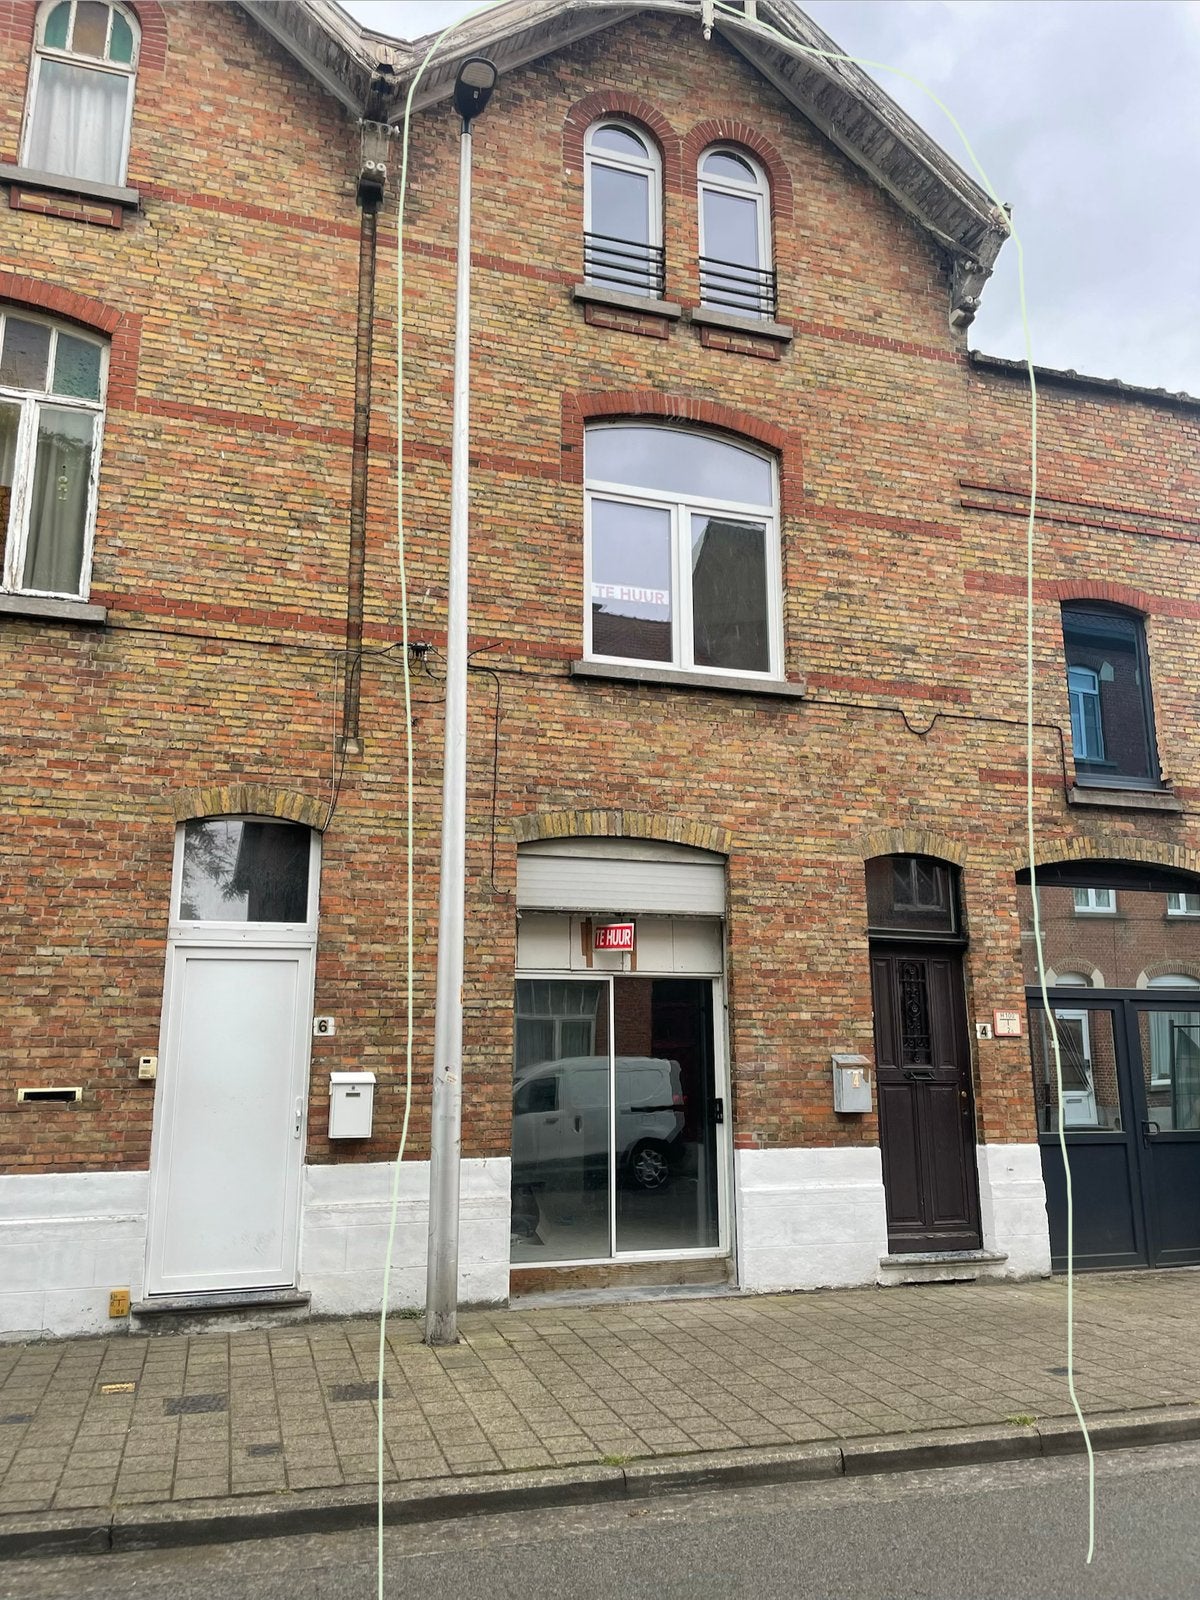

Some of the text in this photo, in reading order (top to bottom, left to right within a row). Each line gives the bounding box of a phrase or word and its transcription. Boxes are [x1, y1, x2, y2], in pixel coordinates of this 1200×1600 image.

[595, 585, 665, 604] TE HUUR
[596, 929, 631, 945] TE HUUR
[319, 1020, 328, 1032] 6
[981, 1026, 988, 1037] 4
